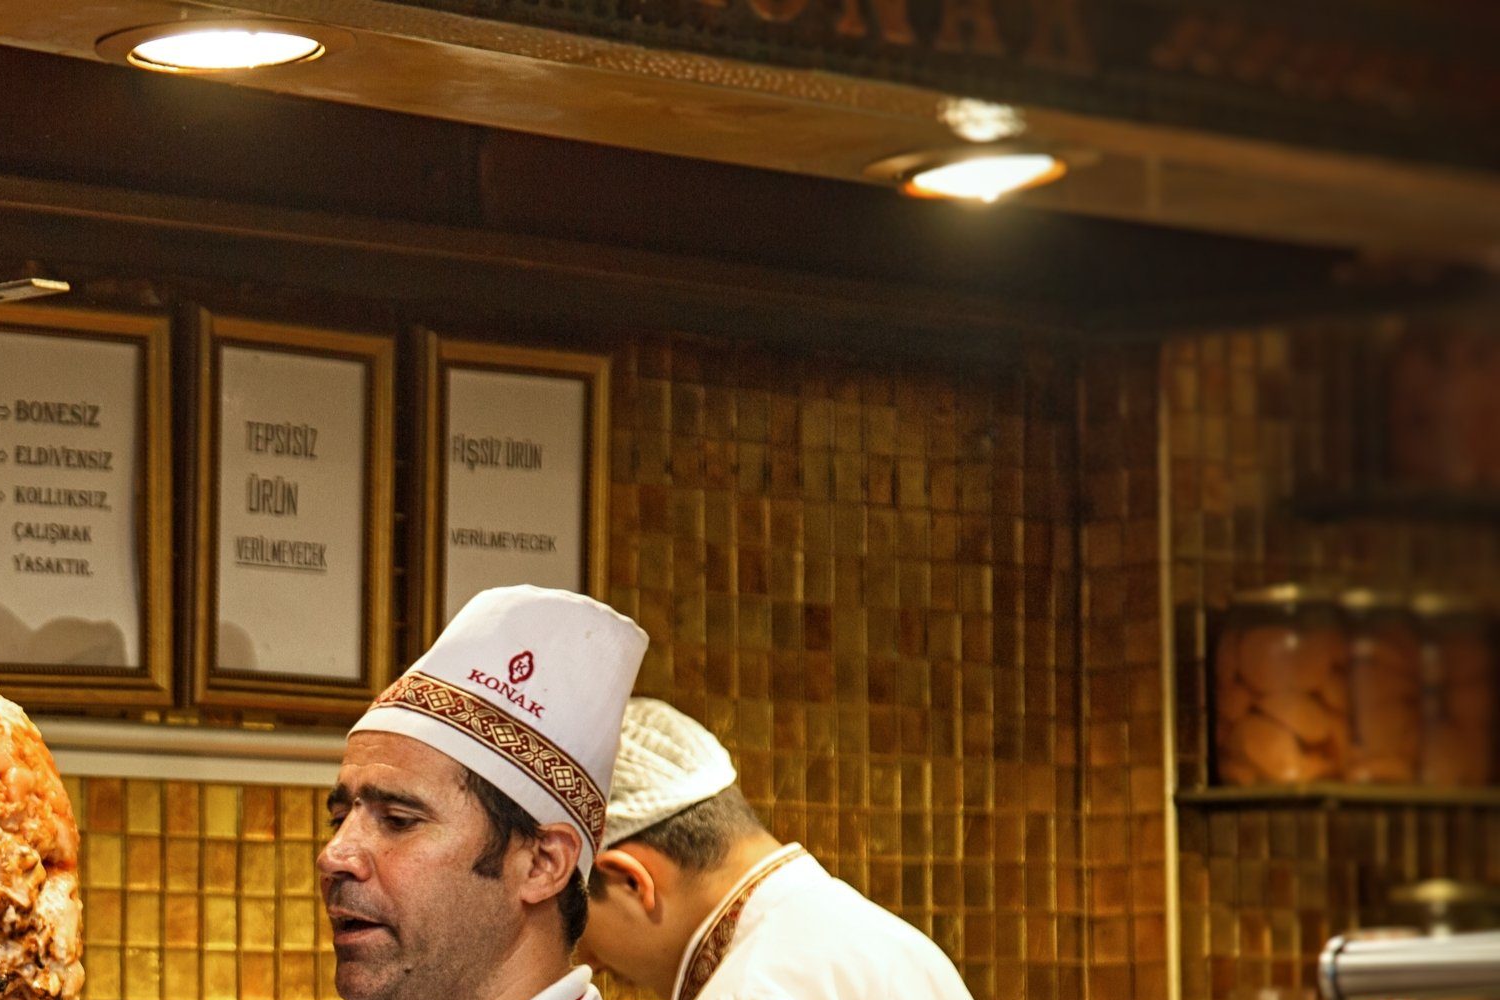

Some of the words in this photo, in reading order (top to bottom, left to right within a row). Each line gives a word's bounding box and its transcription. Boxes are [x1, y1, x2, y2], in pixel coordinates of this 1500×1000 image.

[15, 400, 100, 427] BONESİZ
[246, 421, 318, 459] TEPSİSİZ
[506, 437, 542, 469] ÜRÜN
[247, 473, 298, 516] ÜRÜN
[13, 521, 92, 544] ÇALIŞMAK
[451, 529, 557, 552] VERİLMEYECEK
[235, 536, 328, 568] VERİLMEYECEK
[468, 669, 546, 719] KONAK
